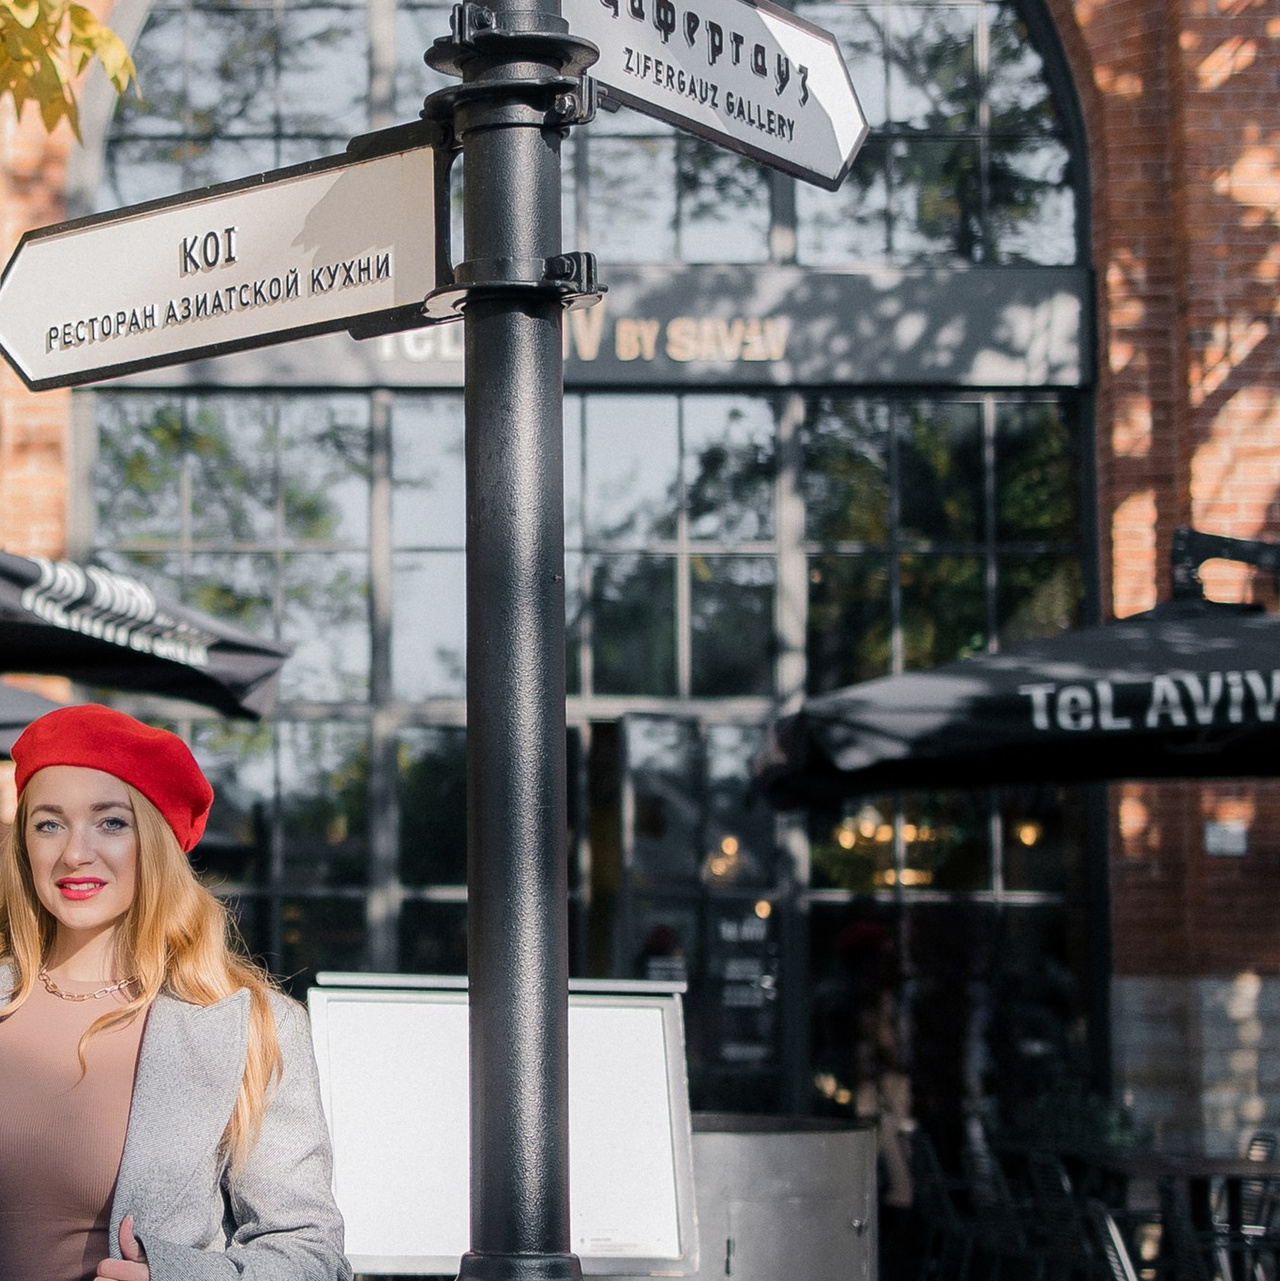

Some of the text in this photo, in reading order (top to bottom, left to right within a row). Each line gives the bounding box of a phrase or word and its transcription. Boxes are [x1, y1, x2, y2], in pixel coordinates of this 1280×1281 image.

[622, 46, 796, 142] ZIFERGAUZ GALLERY
[180, 226, 238, 274] KOI
[47, 252, 392, 349] РЕСТОРАН АЗИАТСКОЙ КУХНИ
